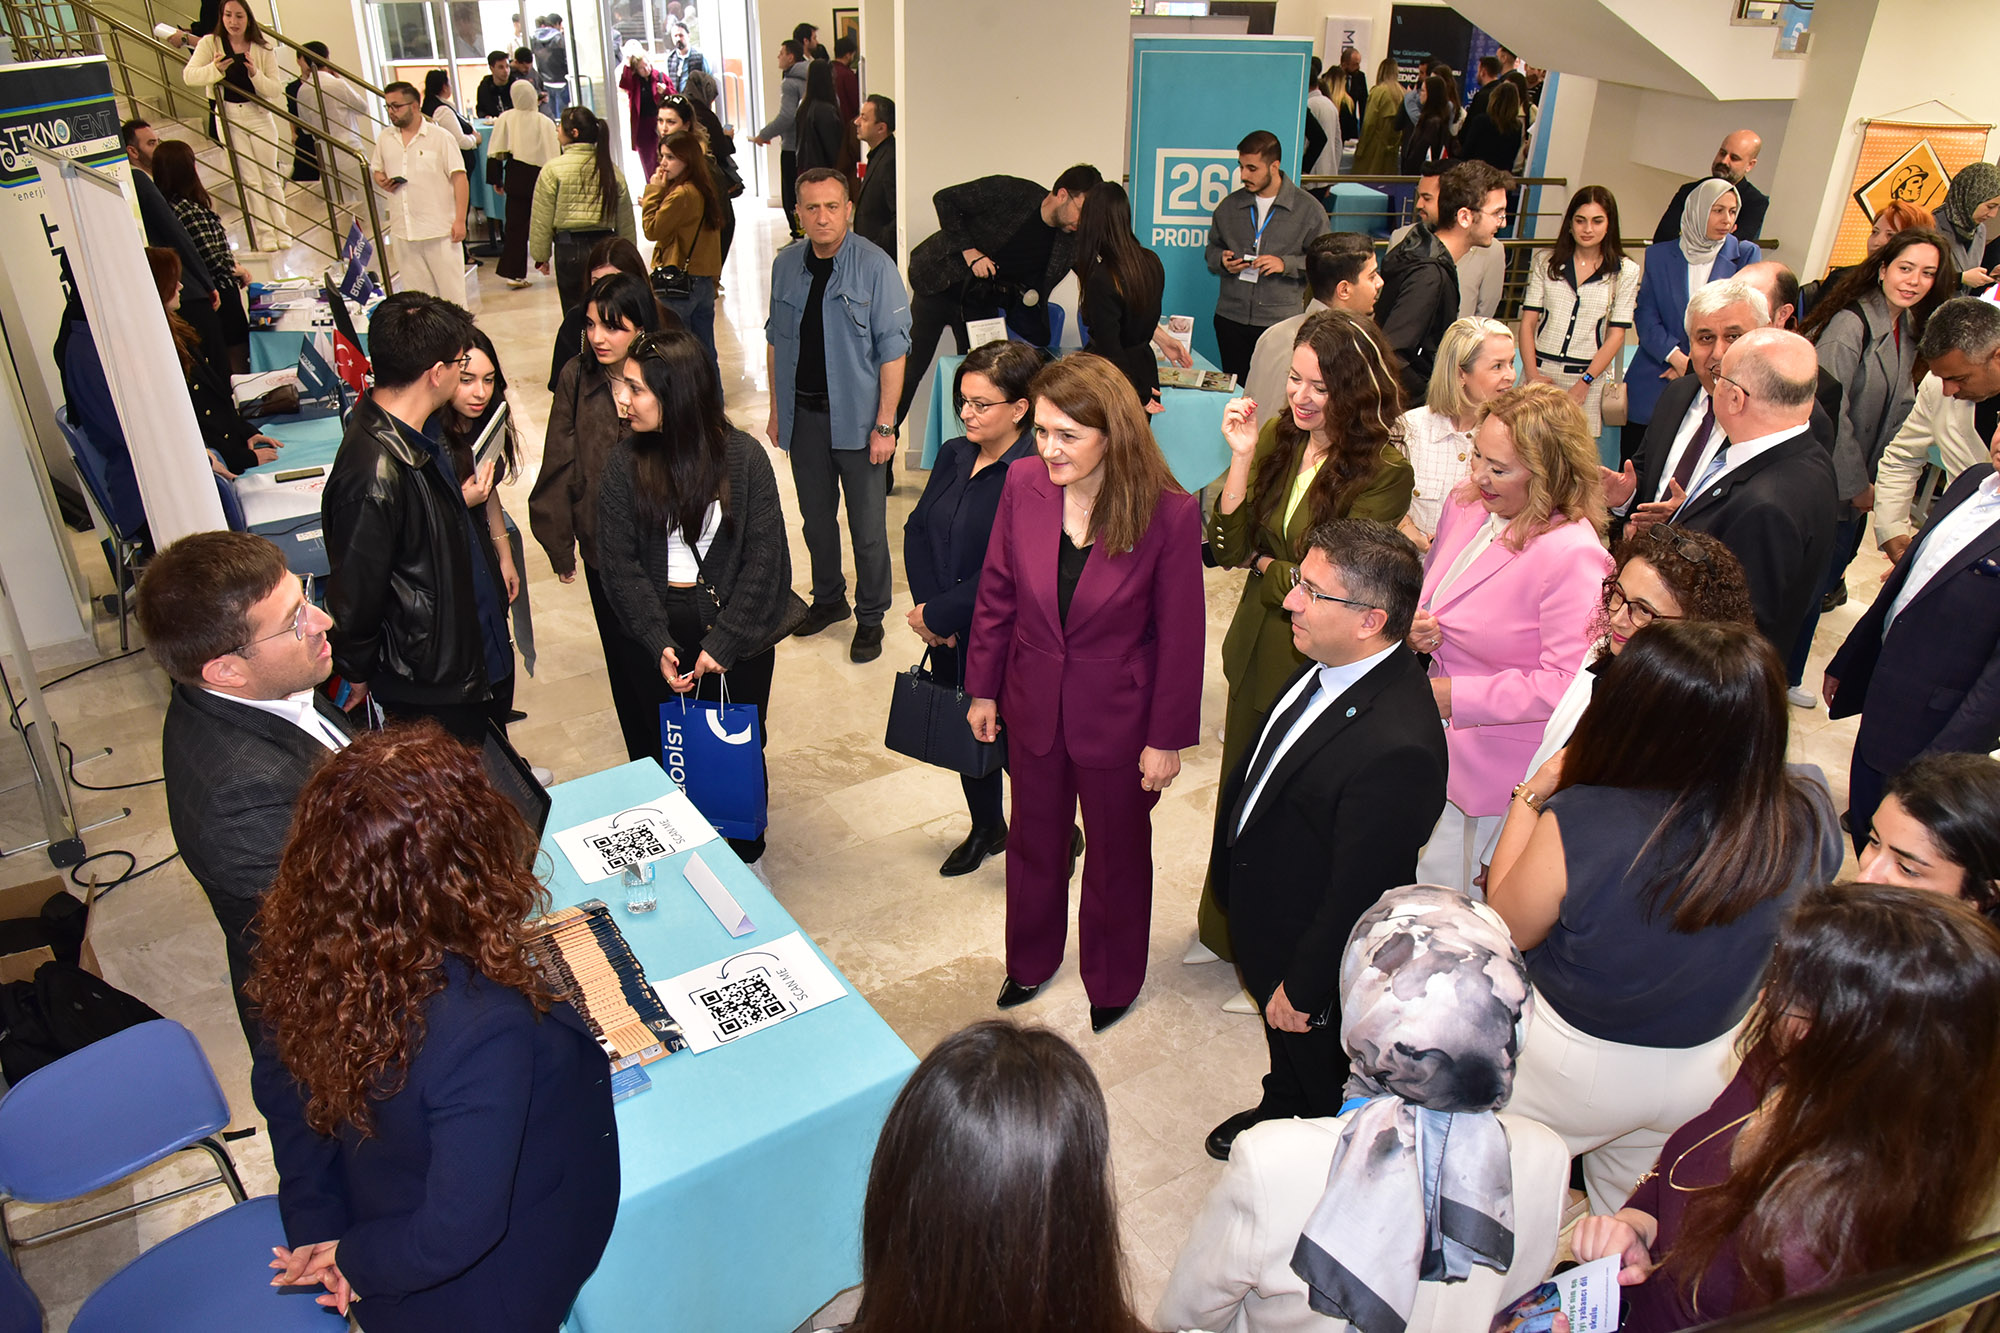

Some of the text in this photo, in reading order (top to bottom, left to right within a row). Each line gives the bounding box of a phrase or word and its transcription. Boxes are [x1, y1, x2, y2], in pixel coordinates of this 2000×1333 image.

[664, 720, 687, 795] ODİST
[659, 819, 686, 844] SCAN ME
[776, 968, 808, 1001] SCAN ME
